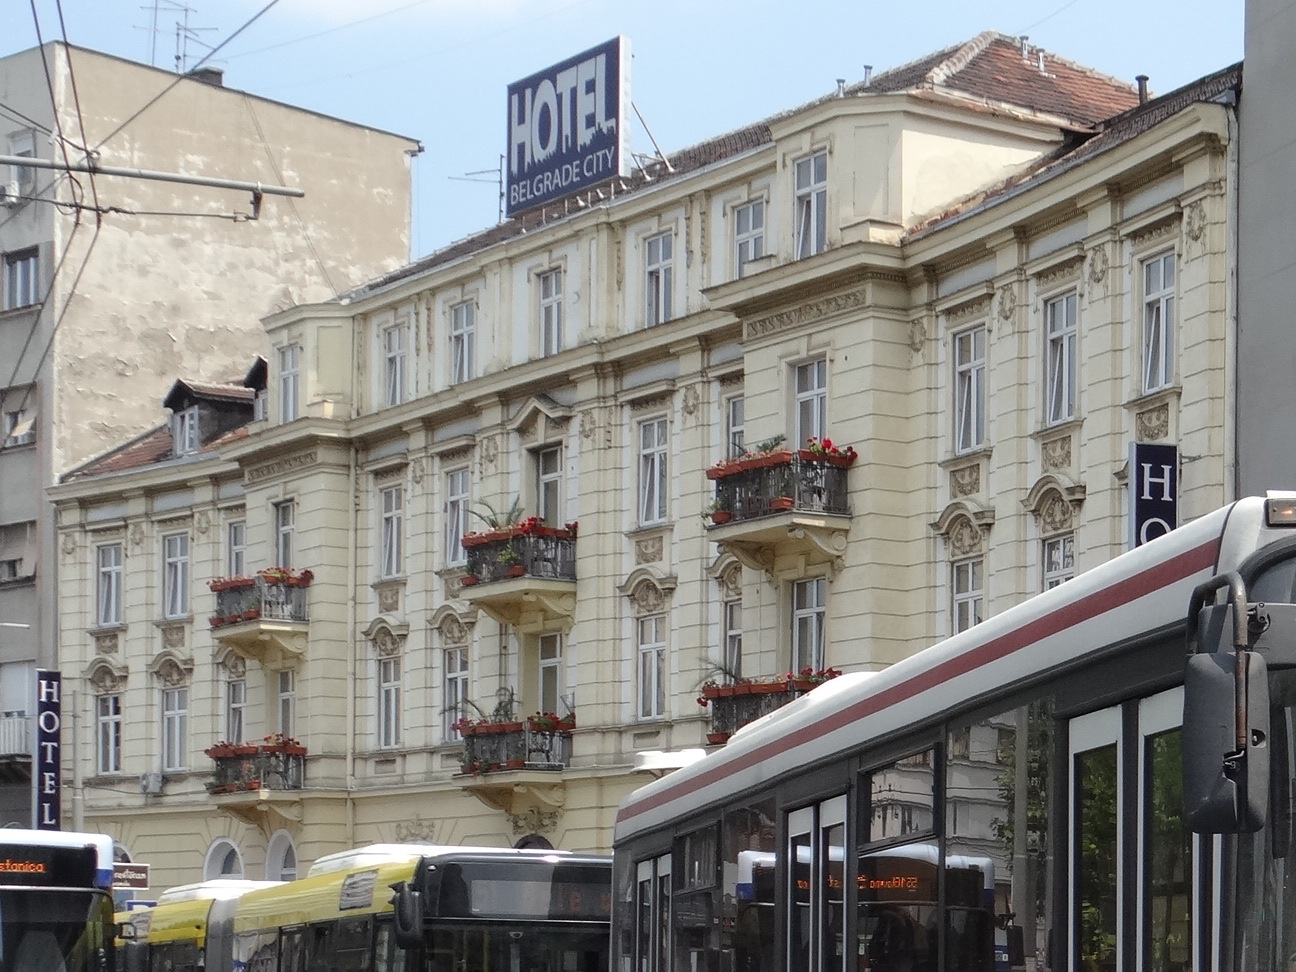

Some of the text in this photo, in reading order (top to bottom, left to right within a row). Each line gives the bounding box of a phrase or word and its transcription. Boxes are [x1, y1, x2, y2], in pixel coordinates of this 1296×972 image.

[510, 53, 616, 178] HOTEL
[510, 146, 614, 206] BELGRADE CITY
[39, 680, 59, 825] HOTEL
